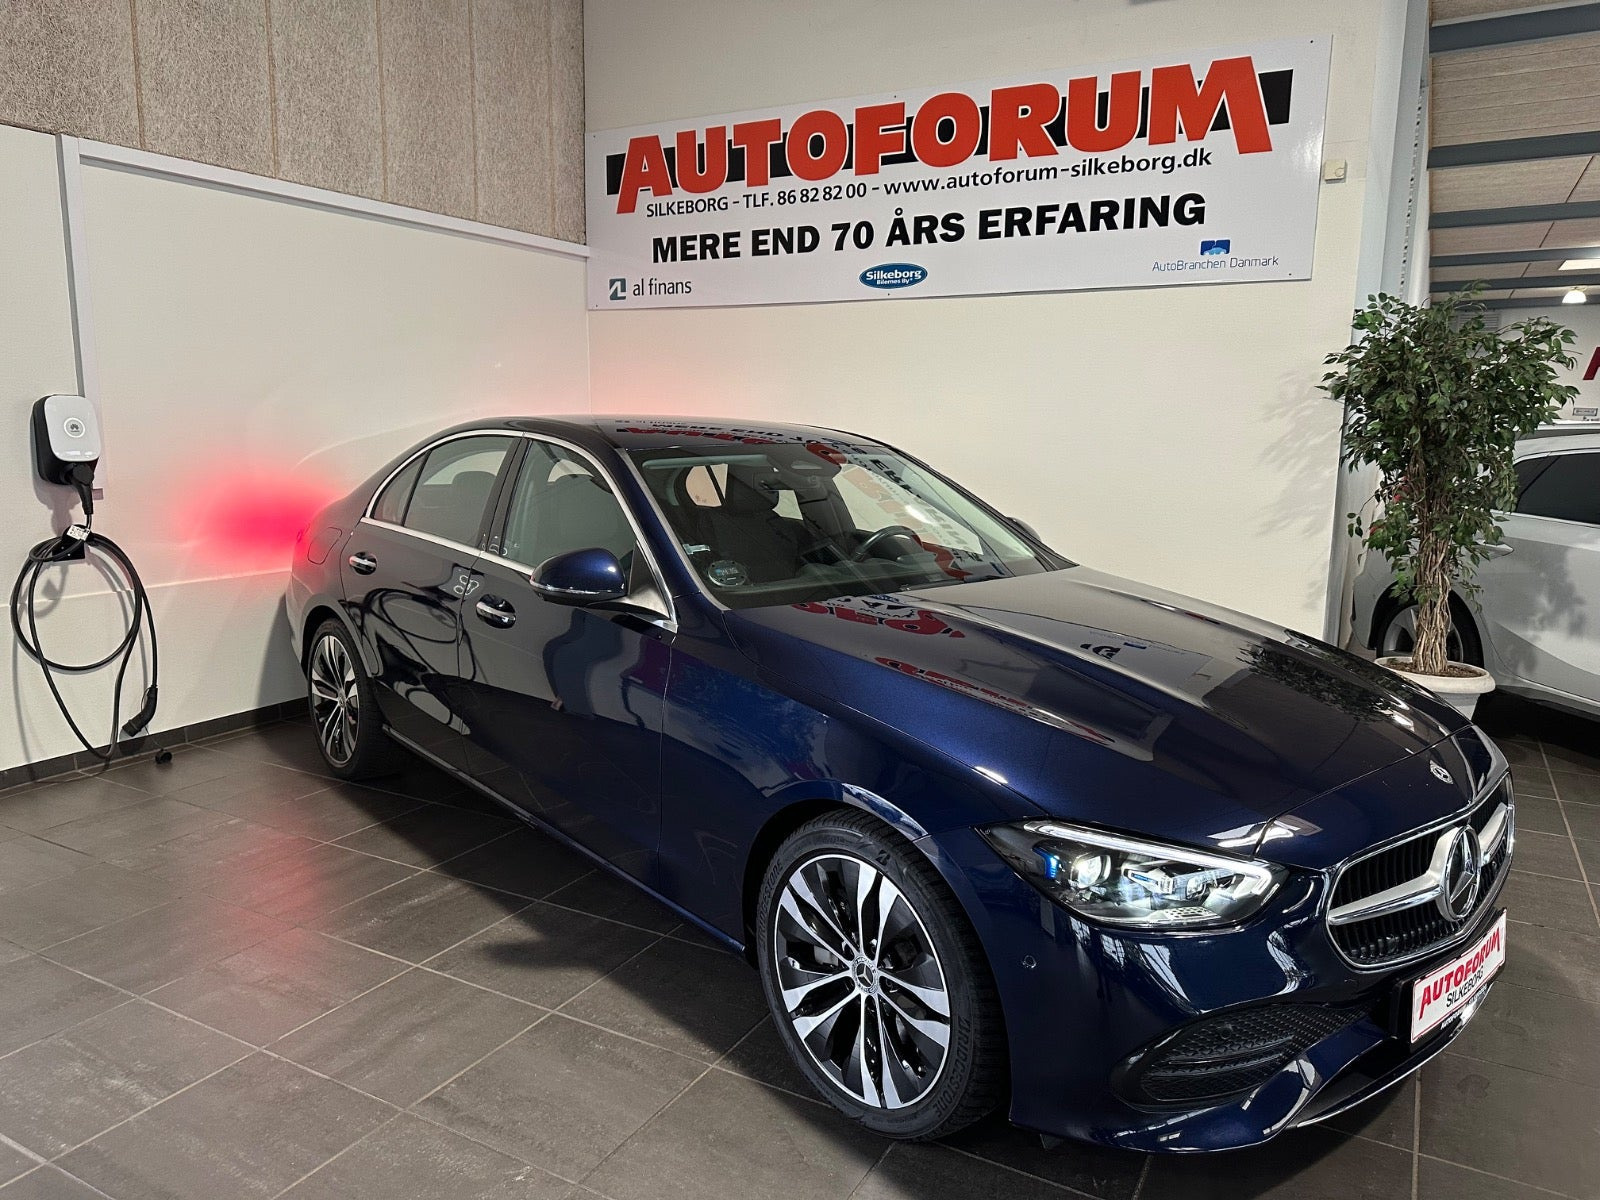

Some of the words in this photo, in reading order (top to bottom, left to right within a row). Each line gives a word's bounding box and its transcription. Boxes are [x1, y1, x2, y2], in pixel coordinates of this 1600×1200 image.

[616, 55, 1273, 214] AUTOFORUM
[646, 196, 729, 218] SILKEBORG
[742, 192, 774, 209] TLF.
[883, 147, 1212, 195] www.autoforum-silkeborg.dk
[652, 231, 741, 264] MERE
[751, 225, 821, 257] END
[831, 220, 875, 251] 70
[885, 207, 965, 247] ÅRS
[978, 192, 1207, 240] ERFARING
[632, 278, 645, 296] al
[648, 277, 692, 296] finans
[865, 269, 922, 281] Silkeborg
[1152, 259, 1226, 272] AutoBranchen
[1230, 256, 1279, 268] Danmark
[1418, 927, 1501, 1021] AUTOFORUM
[1446, 965, 1484, 1008] SILKEBORG
